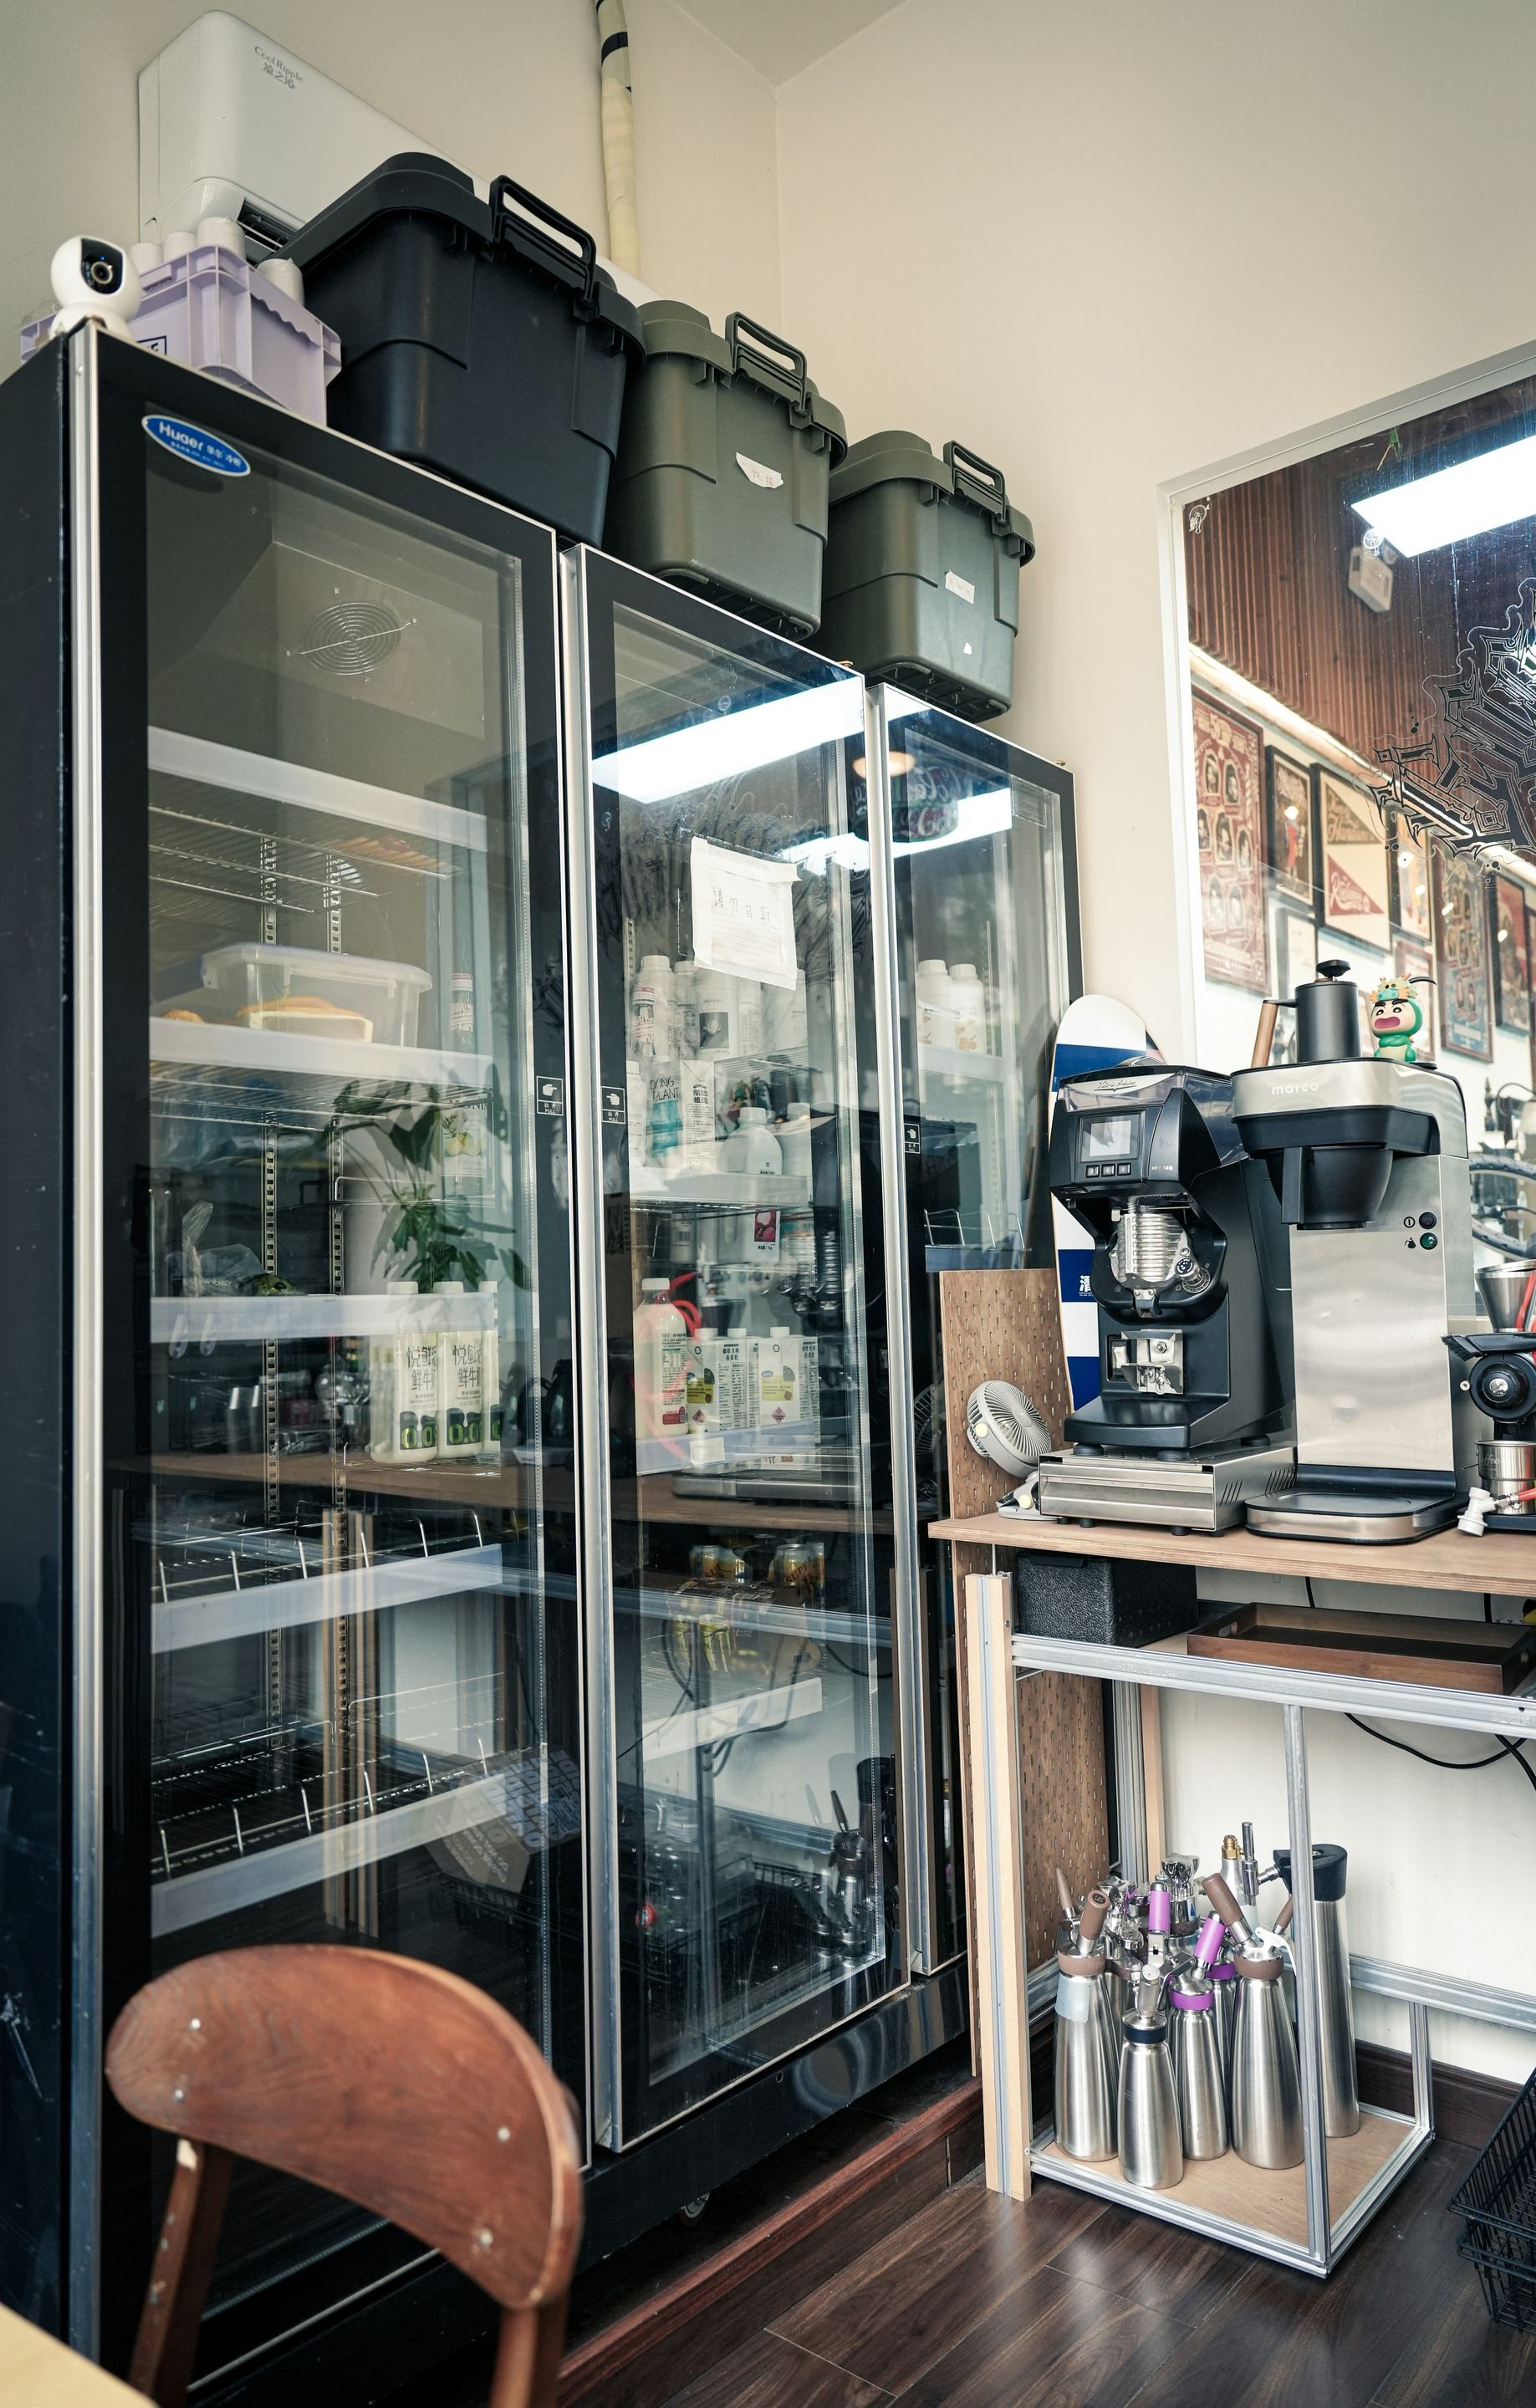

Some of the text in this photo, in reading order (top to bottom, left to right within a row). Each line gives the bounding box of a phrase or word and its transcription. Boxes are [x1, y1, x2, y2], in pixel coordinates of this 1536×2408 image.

[276, 59, 304, 84] Ripple
[159, 421, 204, 451] Huaer
[652, 1087, 679, 1100] PLANT
[1271, 1082, 1319, 1095] marco
